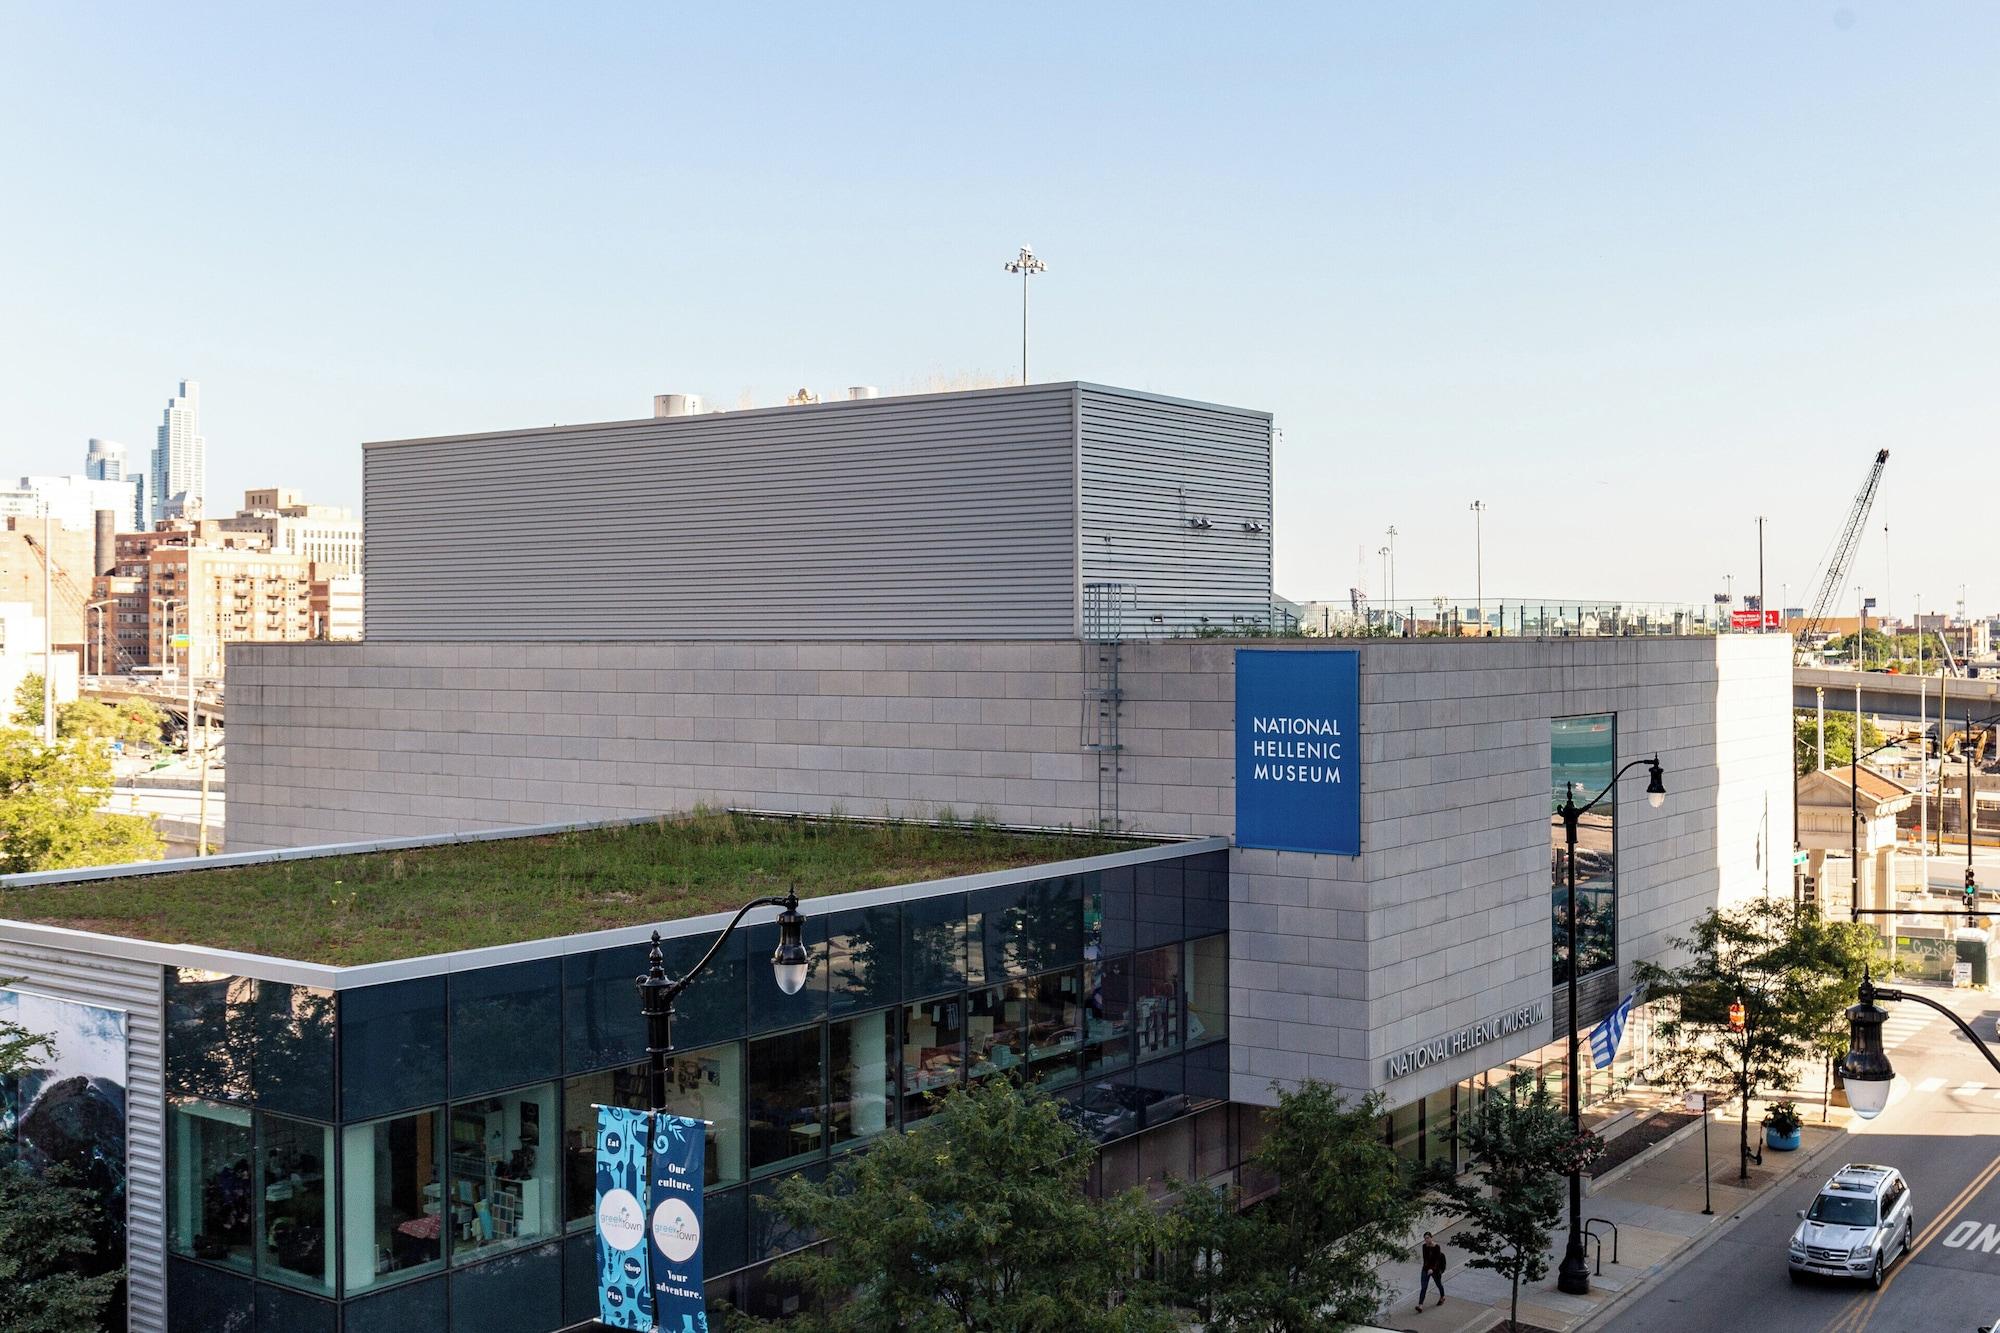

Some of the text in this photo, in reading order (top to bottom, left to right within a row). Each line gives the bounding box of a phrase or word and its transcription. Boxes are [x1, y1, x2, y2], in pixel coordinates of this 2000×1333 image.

[1253, 717, 1340, 735] NATIONAL
[1254, 741, 1340, 760] HELLENIC
[1254, 763, 1340, 783] MUSEUM
[1390, 1002, 1544, 1079] NATIONAL HELLENIC MUSEUM
[607, 1138, 620, 1148] Eat
[668, 1163, 686, 1175] Our
[658, 1178, 694, 1191] culture.
[1942, 1220, 2000, 1254] ON
[624, 1263, 641, 1275] Shop
[666, 1270, 688, 1282] Your
[607, 1292, 622, 1303] Play
[656, 1282, 702, 1300] adventure.
